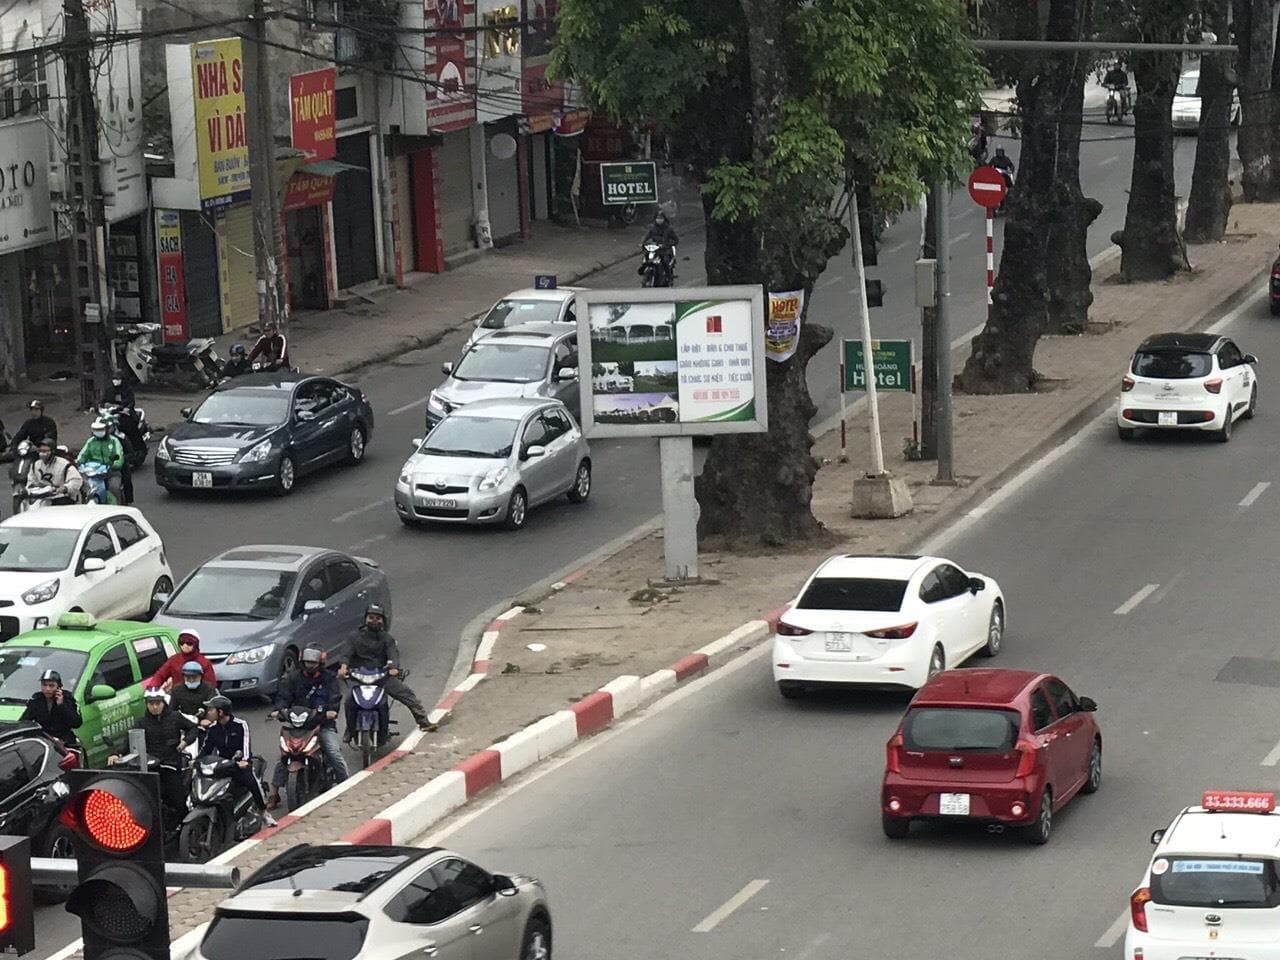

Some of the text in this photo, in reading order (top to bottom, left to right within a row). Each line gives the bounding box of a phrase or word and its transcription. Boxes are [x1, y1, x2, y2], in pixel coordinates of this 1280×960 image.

[196, 53, 245, 99] NHÀ S
[607, 182, 652, 194] HOTEL
